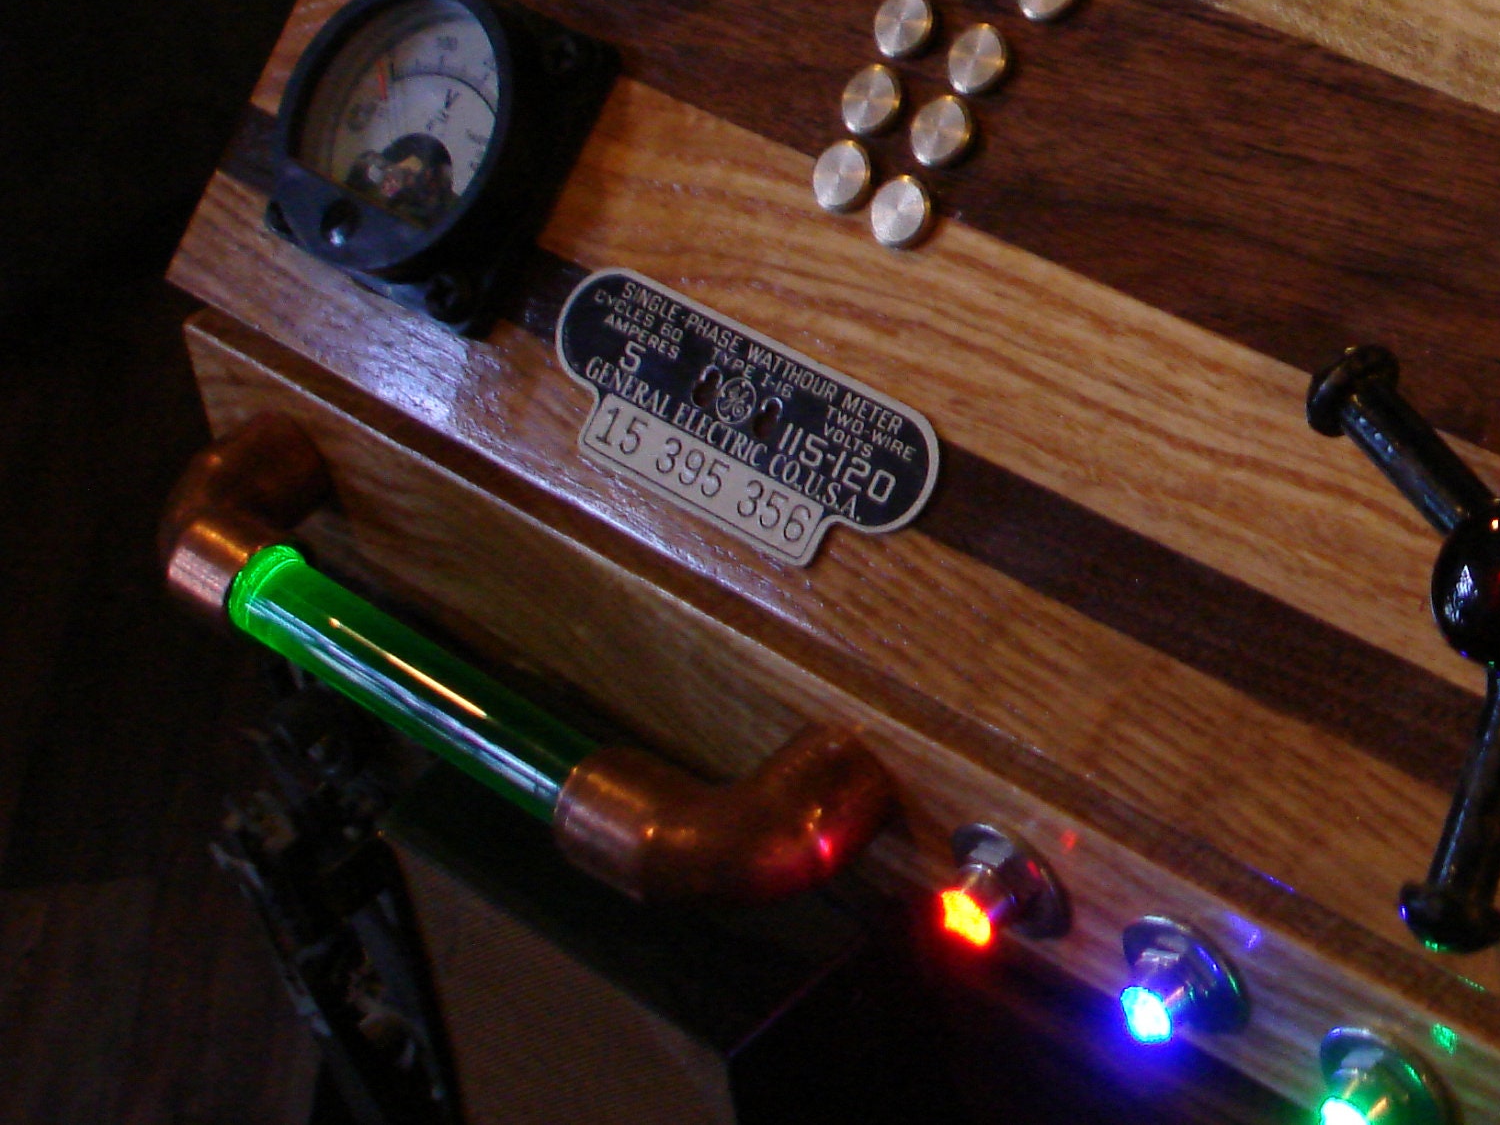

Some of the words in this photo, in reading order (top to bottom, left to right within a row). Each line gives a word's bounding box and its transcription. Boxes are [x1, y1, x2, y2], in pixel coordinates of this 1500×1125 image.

[593, 289, 655, 328] CYCLES
[659, 323, 684, 343] 60
[602, 312, 683, 361] AMPERES
[618, 341, 646, 373] 5
[712, 347, 757, 380] TYPE
[586, 356, 673, 419] GENERAL
[673, 402, 768, 467] ELECTRIC
[747, 343, 839, 402] WATTHOUR
[841, 391, 903, 436] METER
[823, 423, 875, 459] VOLTS
[825, 405, 918, 462] TWO-WIRE
[596, 407, 648, 455] 15
[656, 437, 731, 499] 395
[737, 480, 812, 543] 356
[778, 422, 898, 504] 115-120
